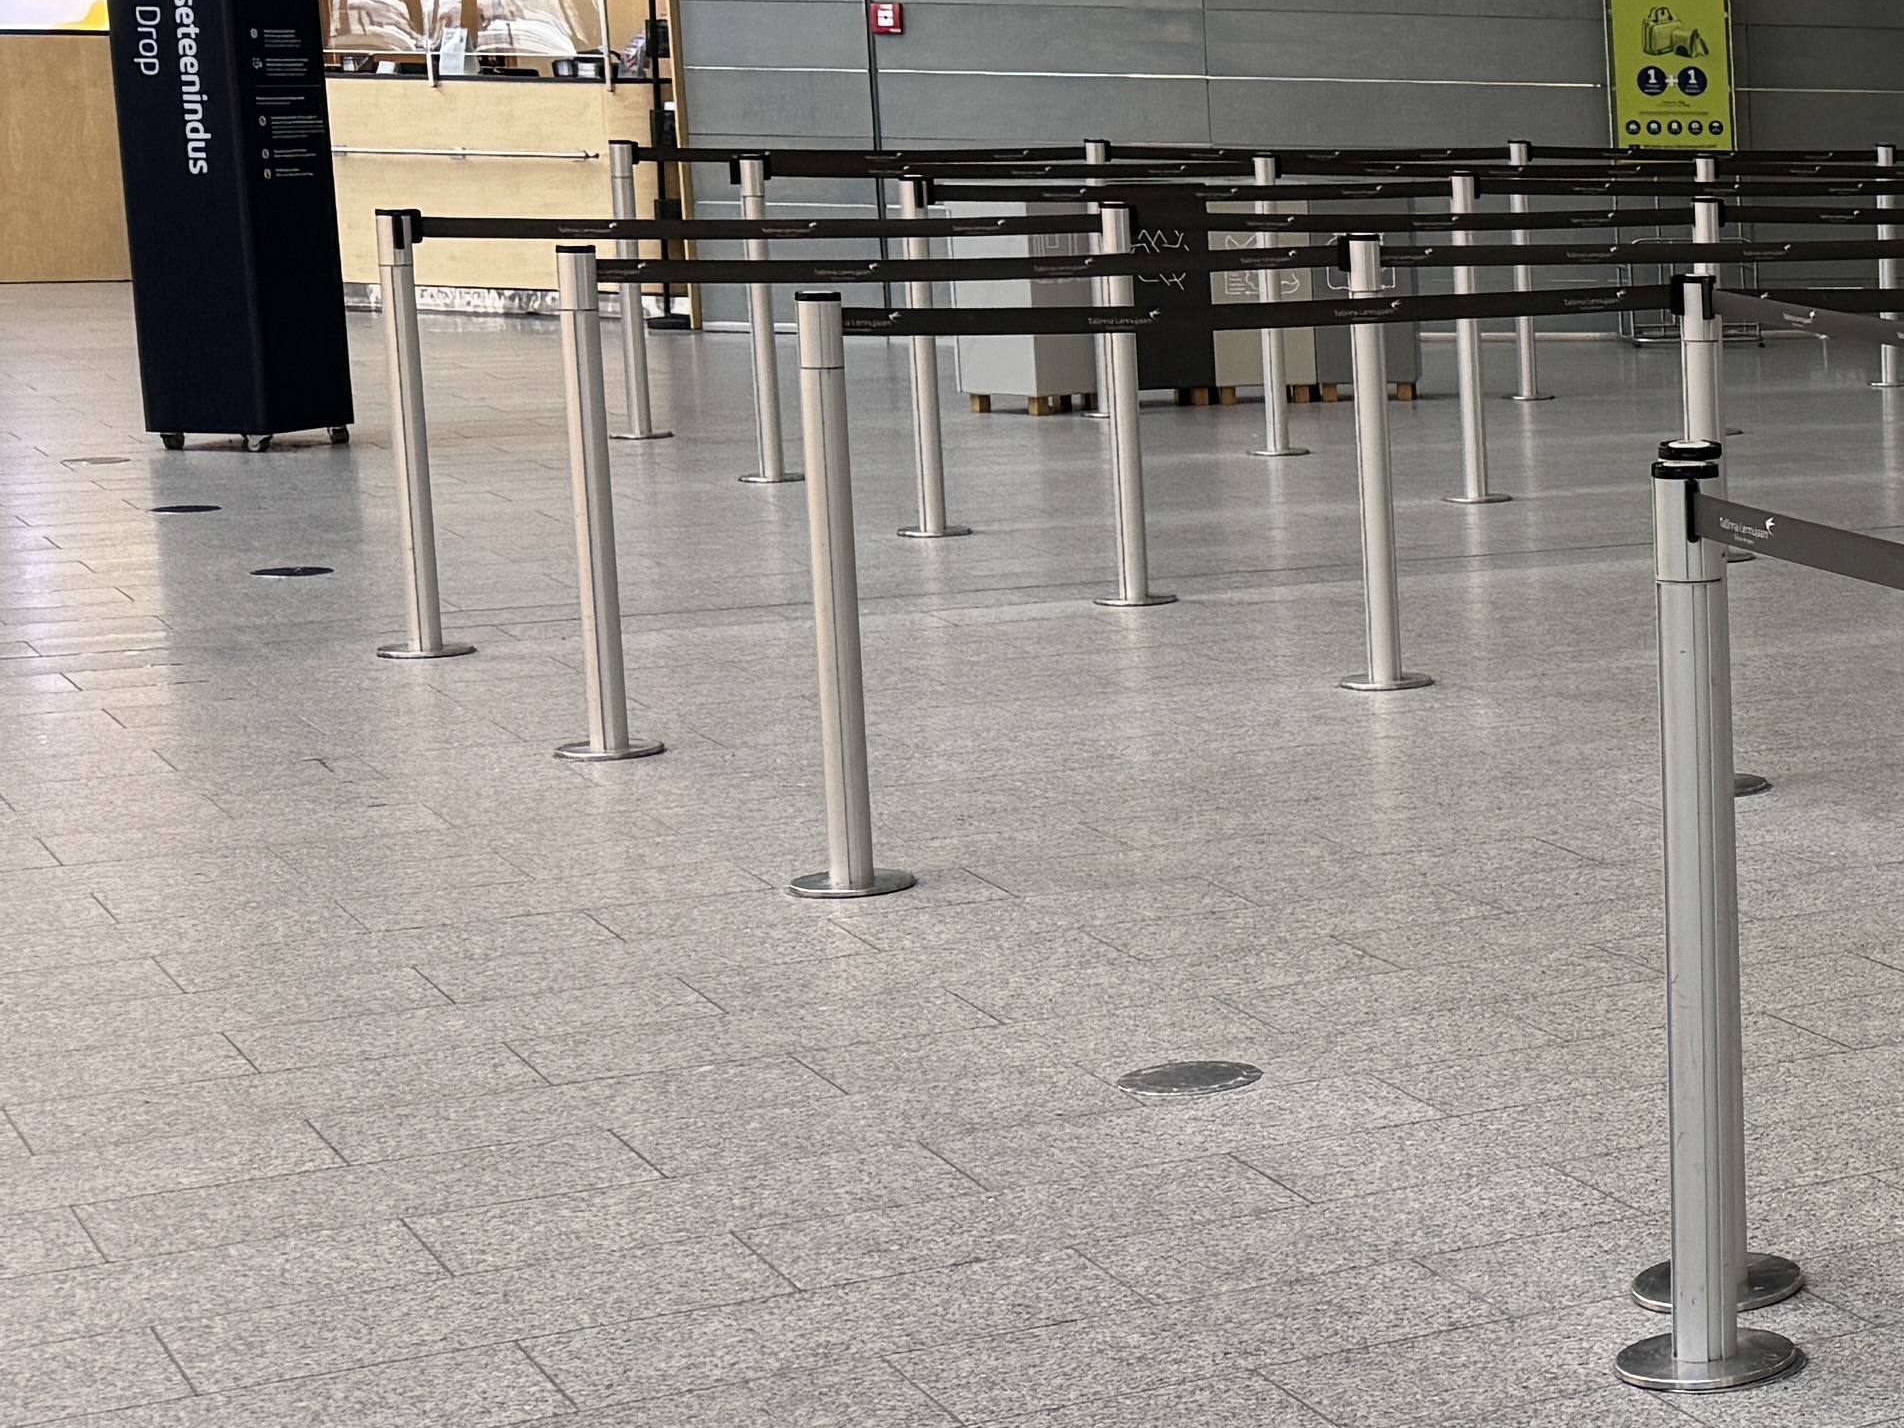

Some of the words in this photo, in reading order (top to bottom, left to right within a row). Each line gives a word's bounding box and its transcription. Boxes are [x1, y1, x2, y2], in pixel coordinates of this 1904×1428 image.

[134, 6, 161, 75] Drop
[1647, 69, 1657, 84] 1
[1687, 69, 1698, 84] 1
